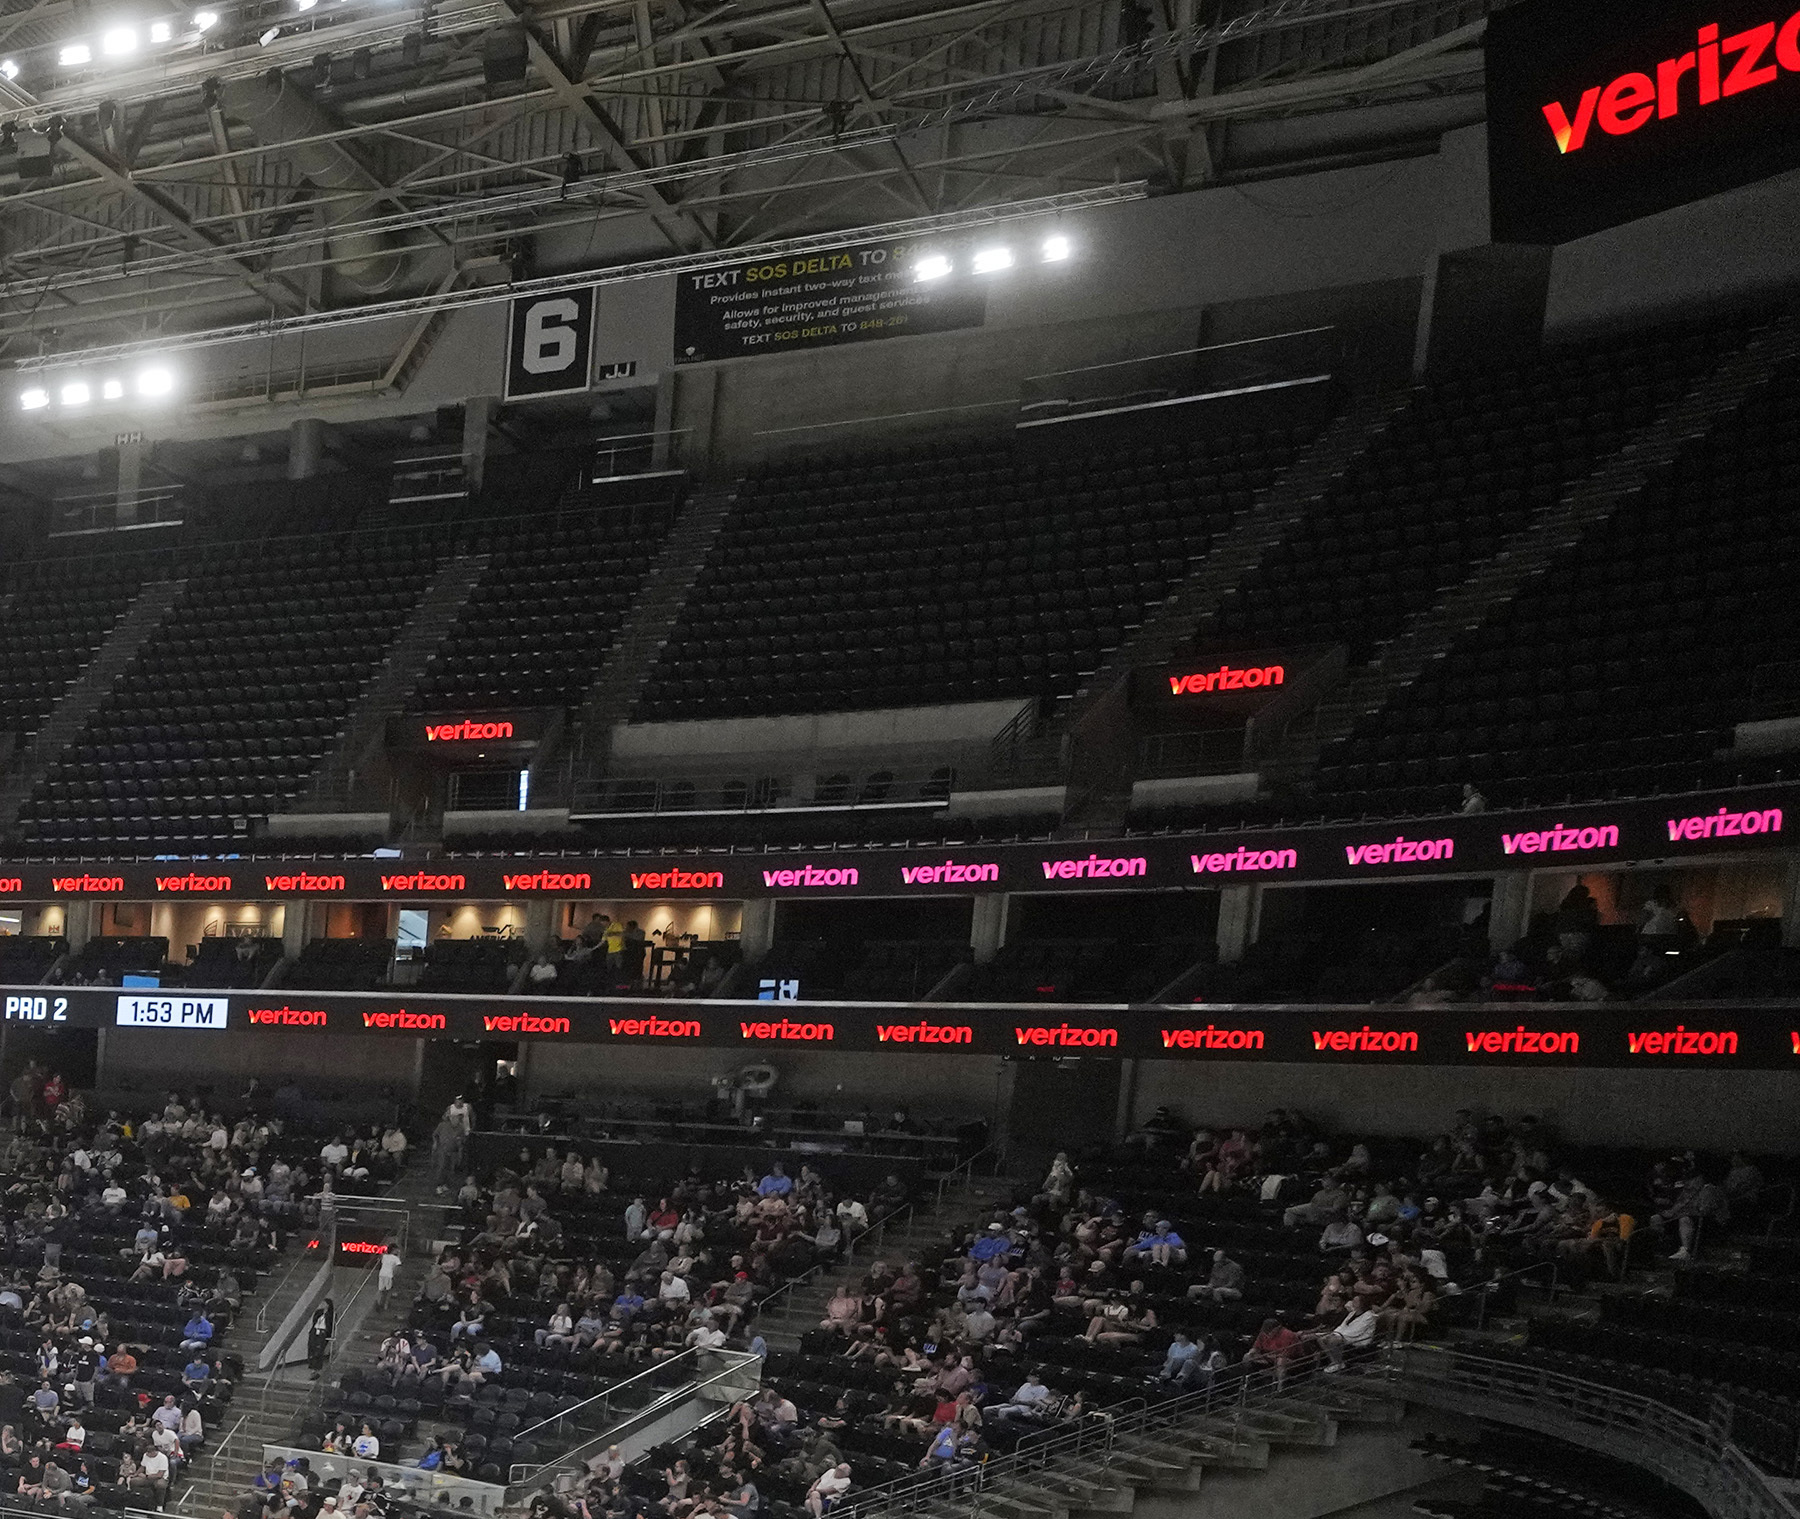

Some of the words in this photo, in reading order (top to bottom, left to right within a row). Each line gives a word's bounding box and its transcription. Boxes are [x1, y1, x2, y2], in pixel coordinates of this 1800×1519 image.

[692, 270, 741, 290] TEXT
[746, 263, 788, 283] SOS
[792, 254, 853, 276] DELTA
[859, 249, 887, 266] TO
[710, 291, 759, 304] Provides
[761, 284, 802, 298] instant
[723, 307, 760, 320] Allows
[762, 304, 780, 315] for
[781, 296, 837, 314] improved
[817, 307, 839, 318] and
[522, 297, 579, 375] 6
[742, 332, 771, 345] TEXT
[774, 329, 799, 342] SOS
[801, 324, 837, 338] DELTA
[840, 321, 857, 333] TO
[1169, 665, 1284, 695] verizon
[425, 719, 513, 741] verizon
[1668, 807, 1782, 841] verizon
[381, 871, 465, 890] verizon
[631, 868, 723, 889] verizon
[1042, 854, 1147, 879] verizon
[5, 998, 47, 1020] PRD
[53, 998, 67, 1020] 2
[131, 1001, 172, 1023] 1:53
[180, 1001, 214, 1024] PM
[248, 1006, 327, 1025] verizon
[740, 1019, 834, 1040] verizon
[1161, 1025, 1264, 1049] verizon
[1628, 1025, 1738, 1054] verizon
